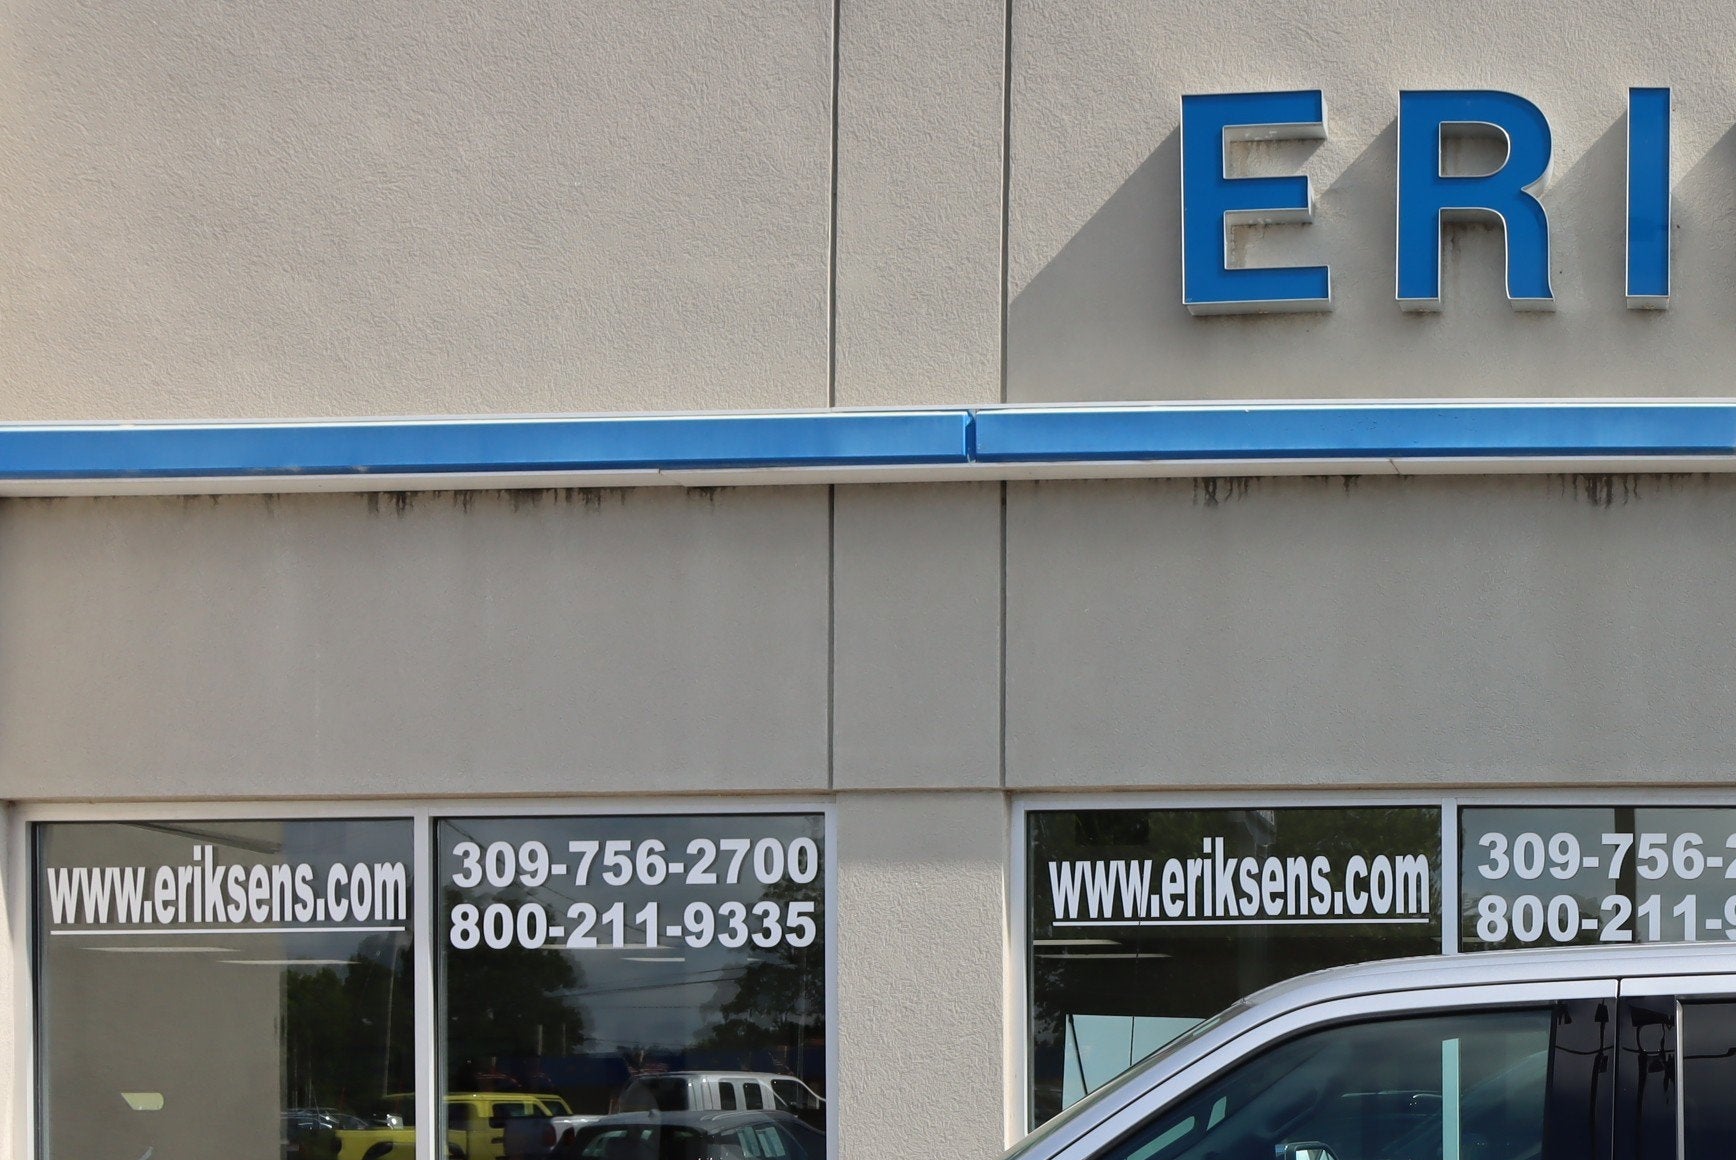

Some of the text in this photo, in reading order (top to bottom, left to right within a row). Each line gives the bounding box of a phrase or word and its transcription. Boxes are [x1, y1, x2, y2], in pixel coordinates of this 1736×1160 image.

[48, 845, 407, 924] www.eriksens.com
[452, 837, 818, 888] 309-756-2700
[1049, 837, 1430, 918] www.eriksens.com
[450, 901, 816, 949] 800-211-9335
